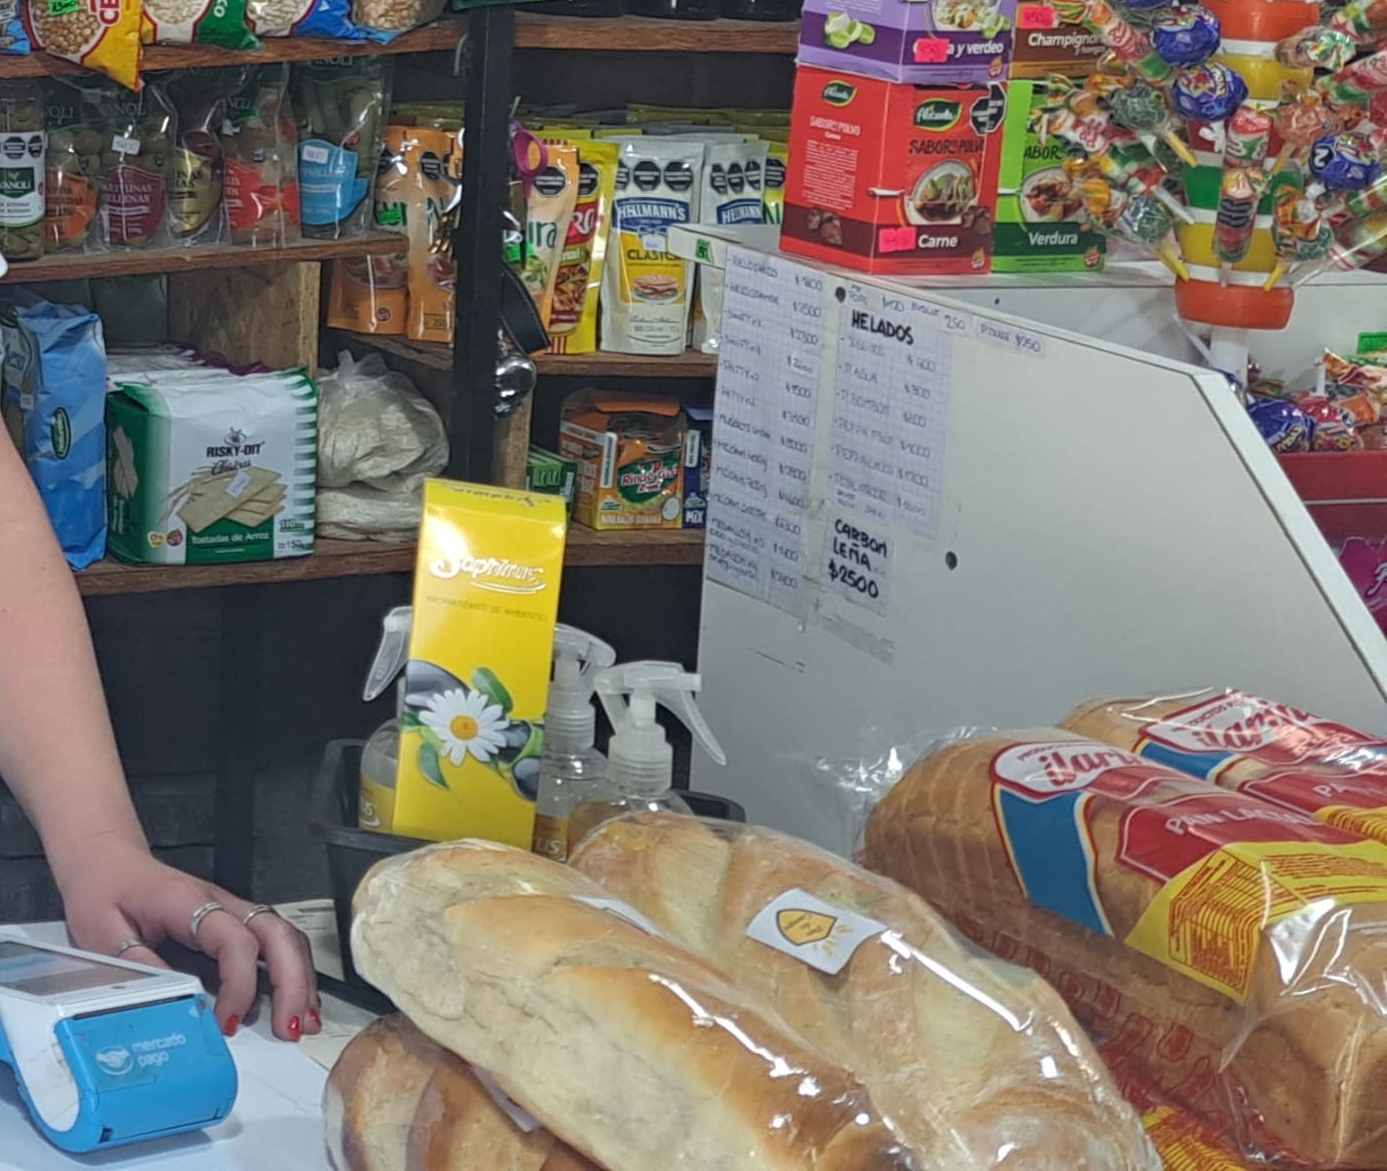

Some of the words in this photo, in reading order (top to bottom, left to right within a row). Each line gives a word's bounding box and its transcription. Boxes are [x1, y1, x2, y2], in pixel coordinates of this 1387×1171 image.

[968, 41, 1004, 57] verdeo
[616, 201, 689, 224] HELLMANN'S
[917, 232, 959, 250] Carne
[1027, 230, 1078, 247] Verdura
[850, 309, 915, 347] HELADOS
[206, 442, 263, 459] RISKY-DIT
[190, 533, 232, 546] Tostadas
[233, 533, 245, 544] de
[245, 532, 269, 544] Arroz
[833, 518, 888, 558] CARBON
[832, 536, 872, 570] LEÑA
[827, 556, 880, 600] $2500
[1164, 810, 1211, 836] PAN
[131, 1031, 188, 1054] mercado
[137, 1050, 171, 1070] pago
